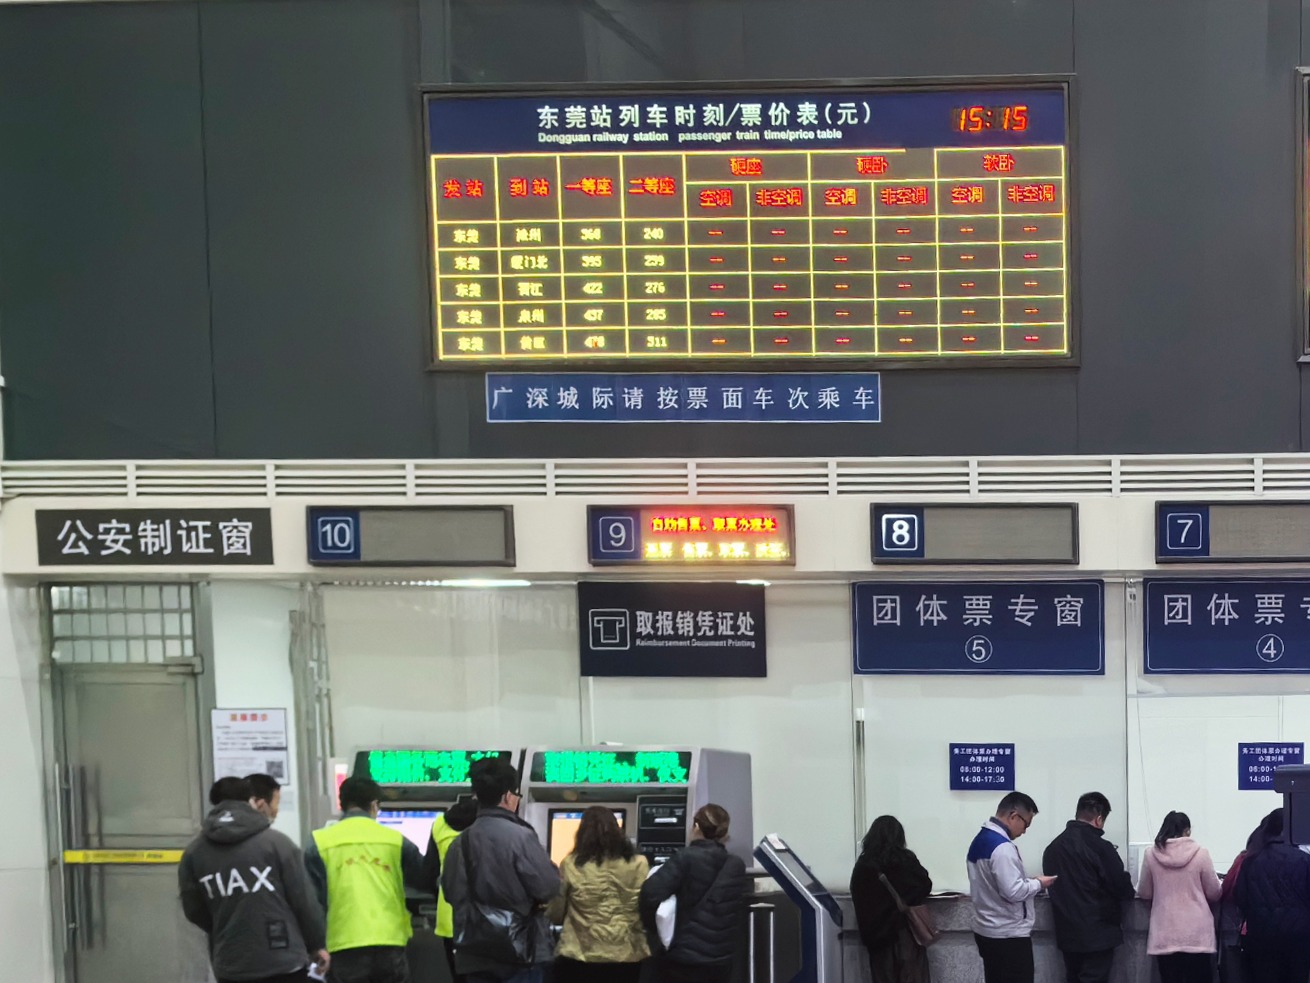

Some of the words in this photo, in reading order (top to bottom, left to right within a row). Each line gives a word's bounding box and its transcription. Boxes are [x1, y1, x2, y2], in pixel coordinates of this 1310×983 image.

[959, 105, 1028, 132] 15:15
[537, 131, 592, 145] Dongguan
[592, 131, 629, 144] railway
[633, 131, 669, 143] station
[678, 131, 732, 144] passenger
[736, 130, 760, 142] train
[764, 129, 815, 142] time/price
[817, 128, 843, 140] table
[628, 176, 676, 196] 二等座
[491, 386, 876, 411] 广深城际请按票面车次乘车
[56, 518, 254, 557] 公安制证窗
[321, 522, 350, 548] 10
[608, 522, 627, 547] 9
[891, 518, 911, 545] 8
[1178, 519, 1194, 543] 7
[635, 610, 756, 637] 取报销凭证处
[872, 594, 1085, 627] 团体票专窗
[635, 638, 691, 648] Reimbursement
[691, 638, 727, 648] Document
[727, 638, 756, 649] Printing
[199, 865, 276, 899] TIAX
